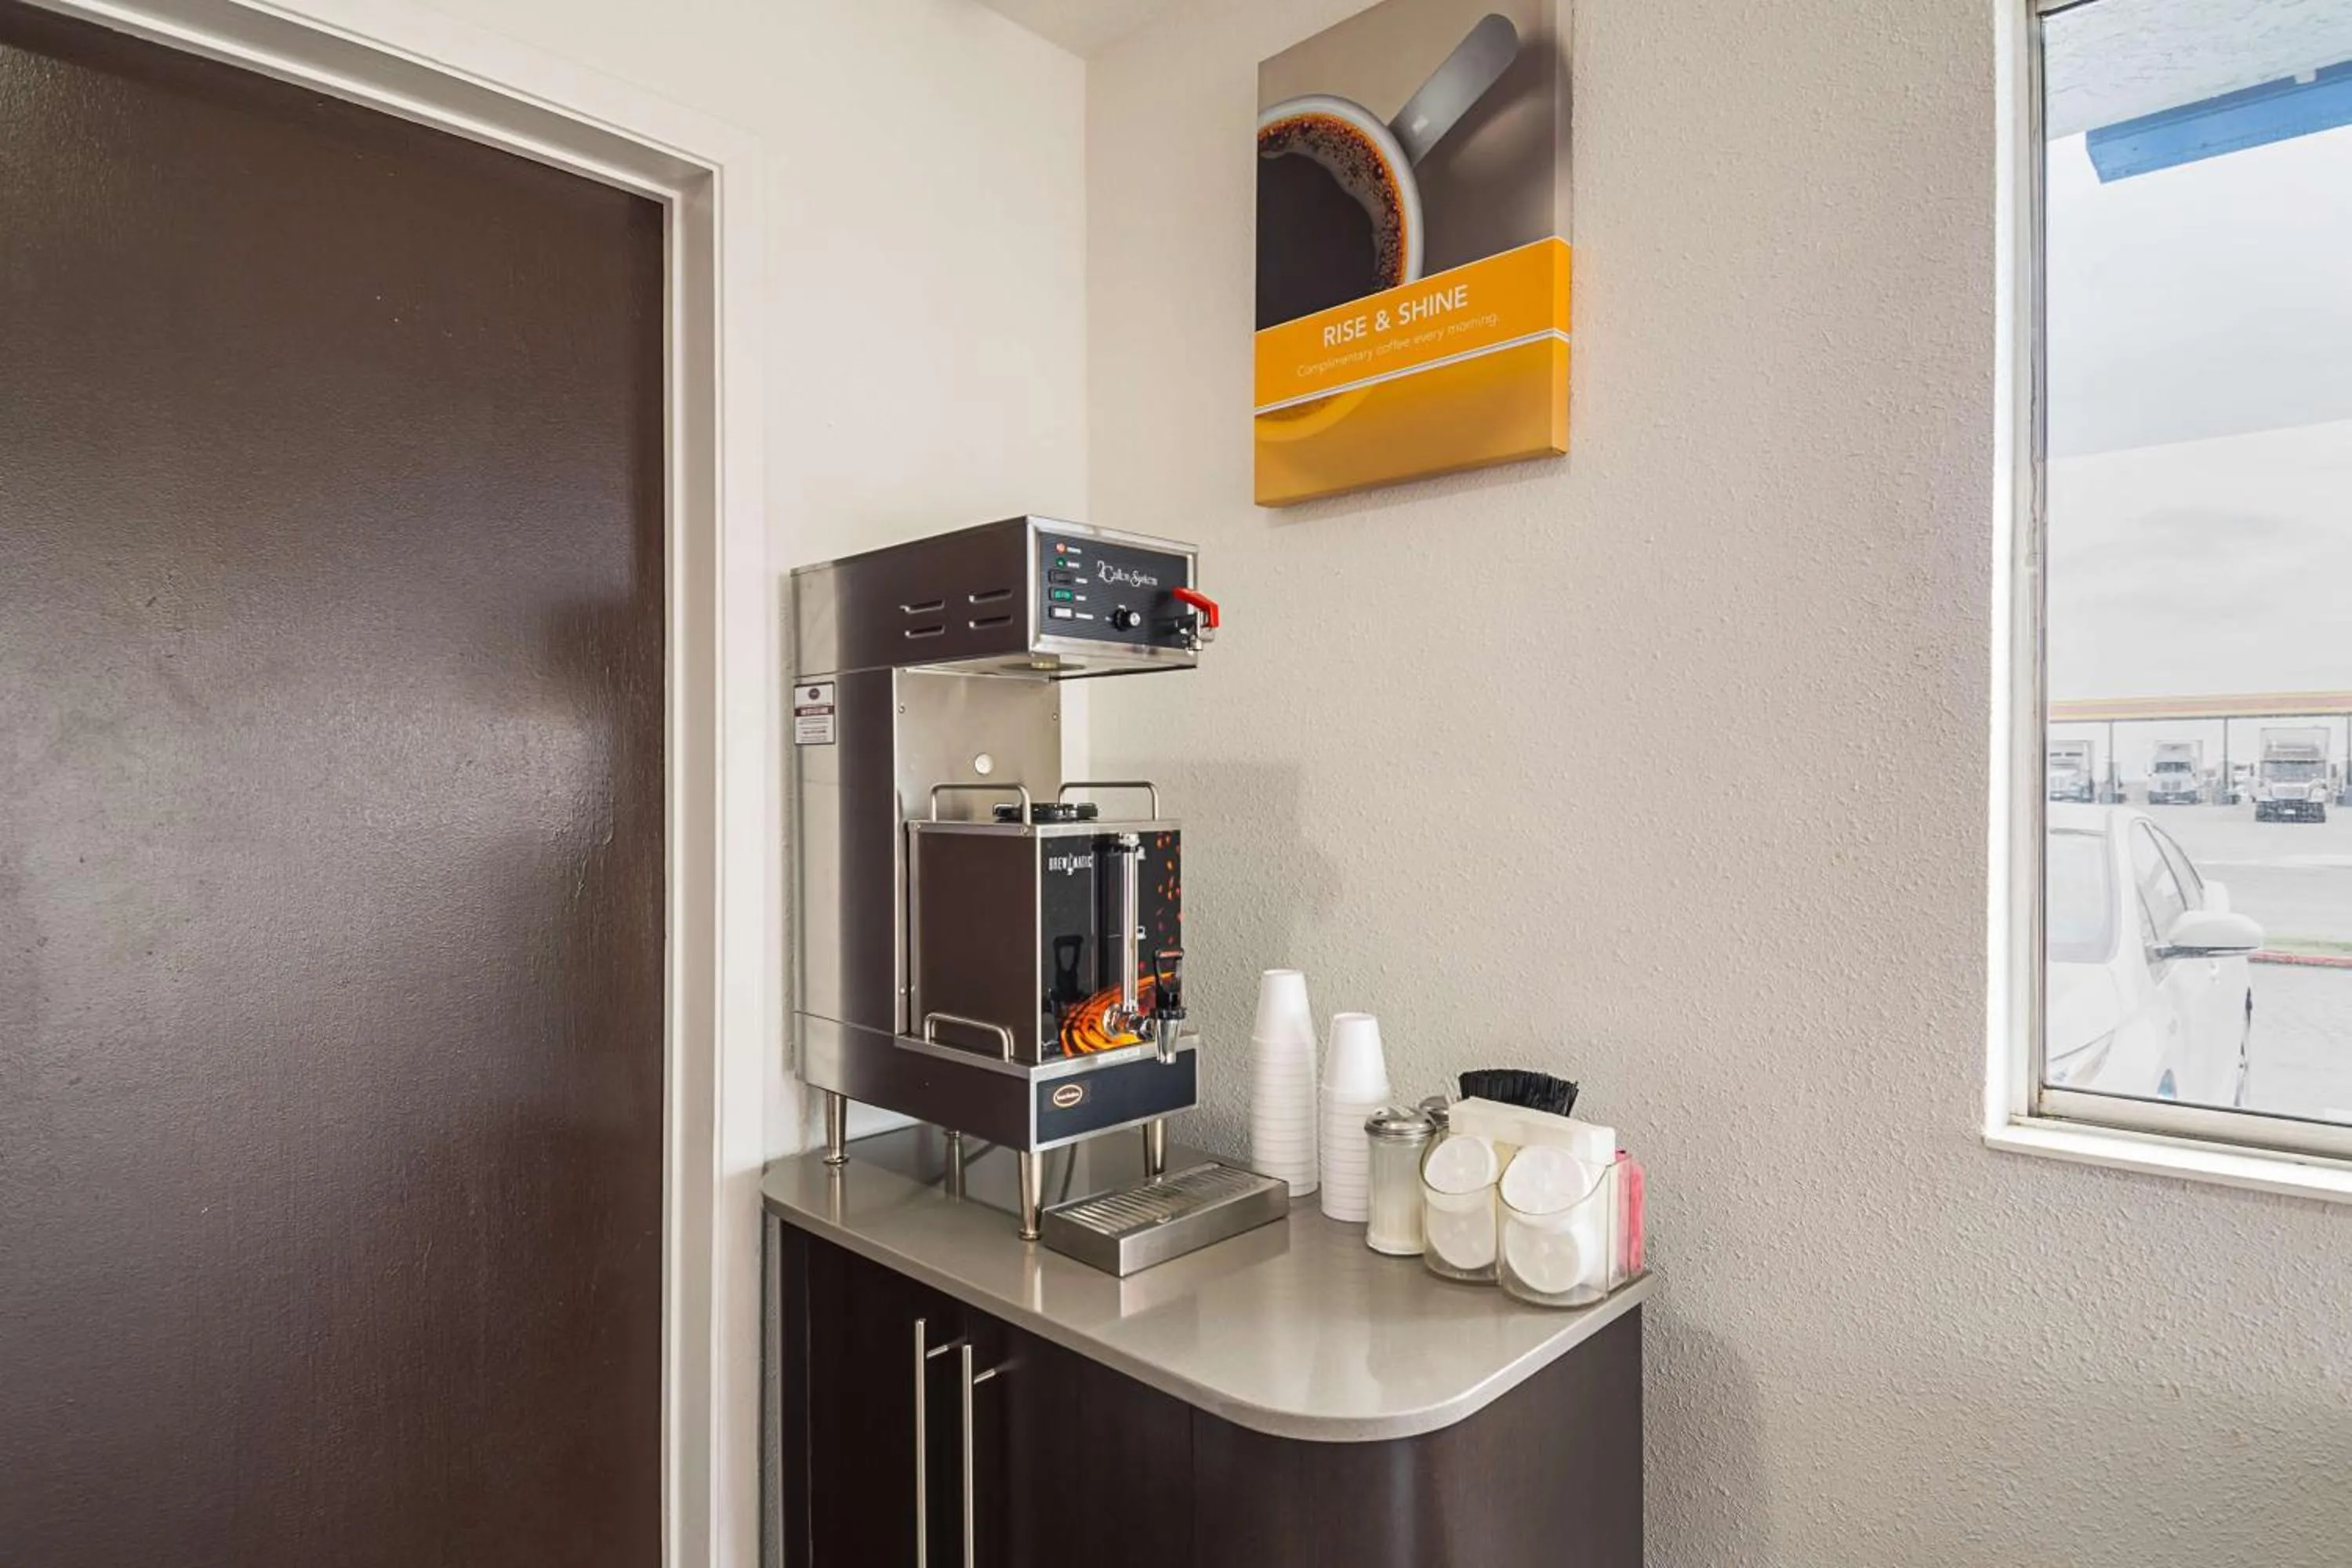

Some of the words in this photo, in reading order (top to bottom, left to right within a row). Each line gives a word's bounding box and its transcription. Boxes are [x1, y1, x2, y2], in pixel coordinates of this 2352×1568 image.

[1323, 315, 1368, 349] RISE
[1374, 310, 1392, 332] &
[1398, 283, 1468, 326] SHINE
[1296, 350, 1374, 378] Complimentary
[1375, 337, 1410, 356] coffee
[1414, 327, 1444, 345] every
